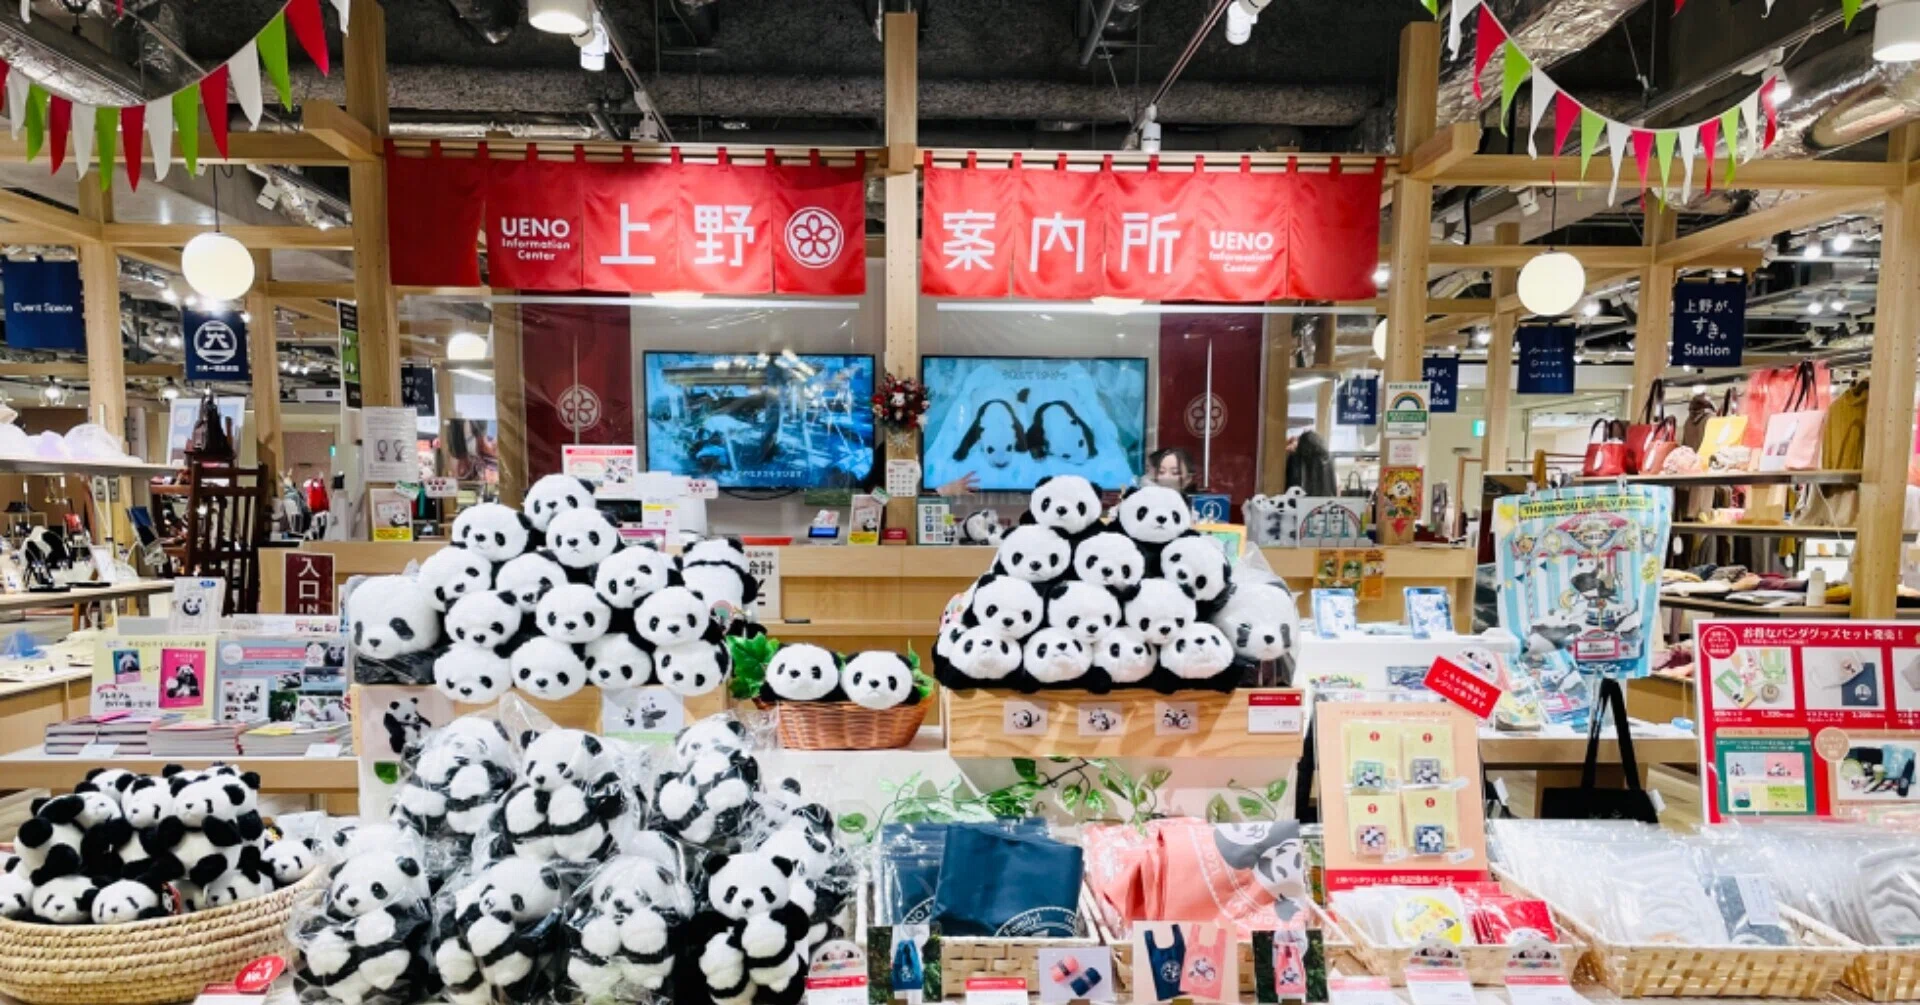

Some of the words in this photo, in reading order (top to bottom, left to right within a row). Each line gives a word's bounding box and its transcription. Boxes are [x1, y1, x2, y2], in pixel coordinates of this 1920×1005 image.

[501, 216, 570, 238] UENO
[600, 203, 755, 267] 上野
[943, 209, 1181, 274] 案内所
[1209, 229, 1274, 251] UENO
[502, 238, 571, 250] Information
[517, 250, 556, 261] Center
[1208, 250, 1273, 263] Information
[1222, 262, 1259, 272] Center
[13, 302, 42, 313] Event
[43, 302, 73, 313] Space
[1683, 298, 1733, 314] 上野が、
[1691, 316, 1728, 340] すき。
[1683, 343, 1731, 357] Station
[298, 557, 321, 600] 入口
[299, 603, 319, 614] IN
